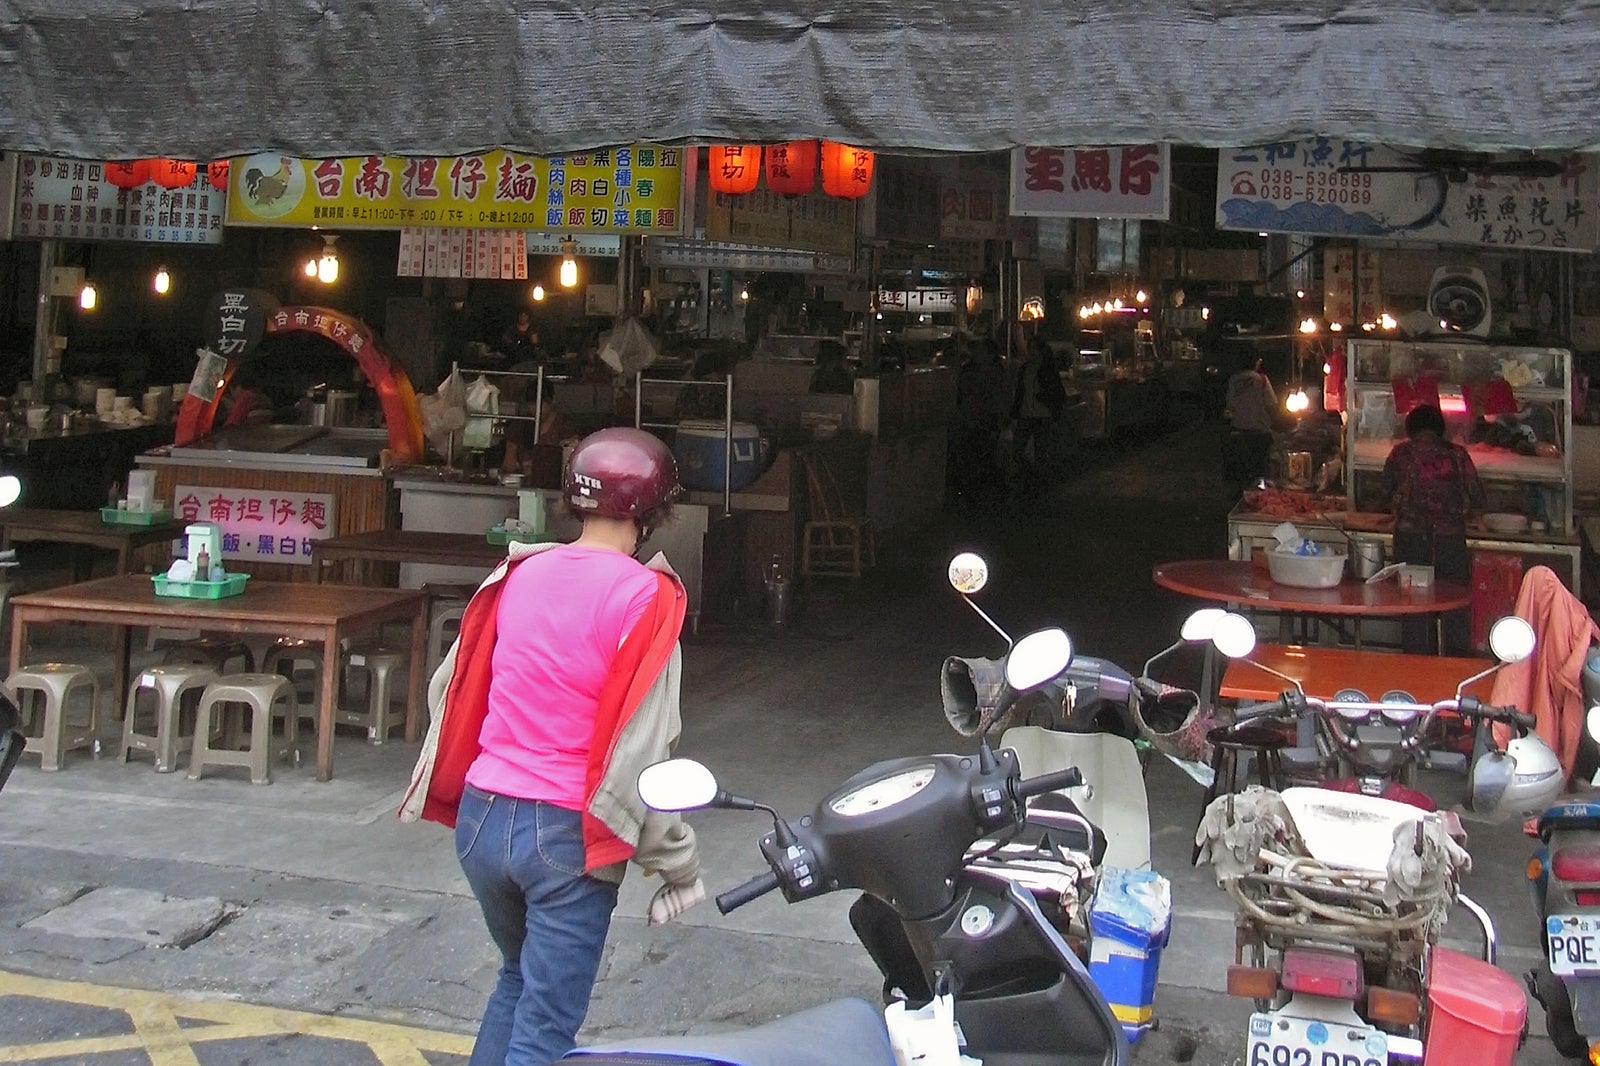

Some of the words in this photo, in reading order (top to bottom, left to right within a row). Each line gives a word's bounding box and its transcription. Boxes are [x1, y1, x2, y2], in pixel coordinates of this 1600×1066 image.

[591, 151, 611, 227] 黑白切
[613, 149, 633, 227] 各種小菜
[636, 149, 655, 227] 陽春麵
[660, 150, 677, 227] 拉麵
[219, 292, 249, 355] 黑白切
[1550, 936, 1598, 964] PQE
